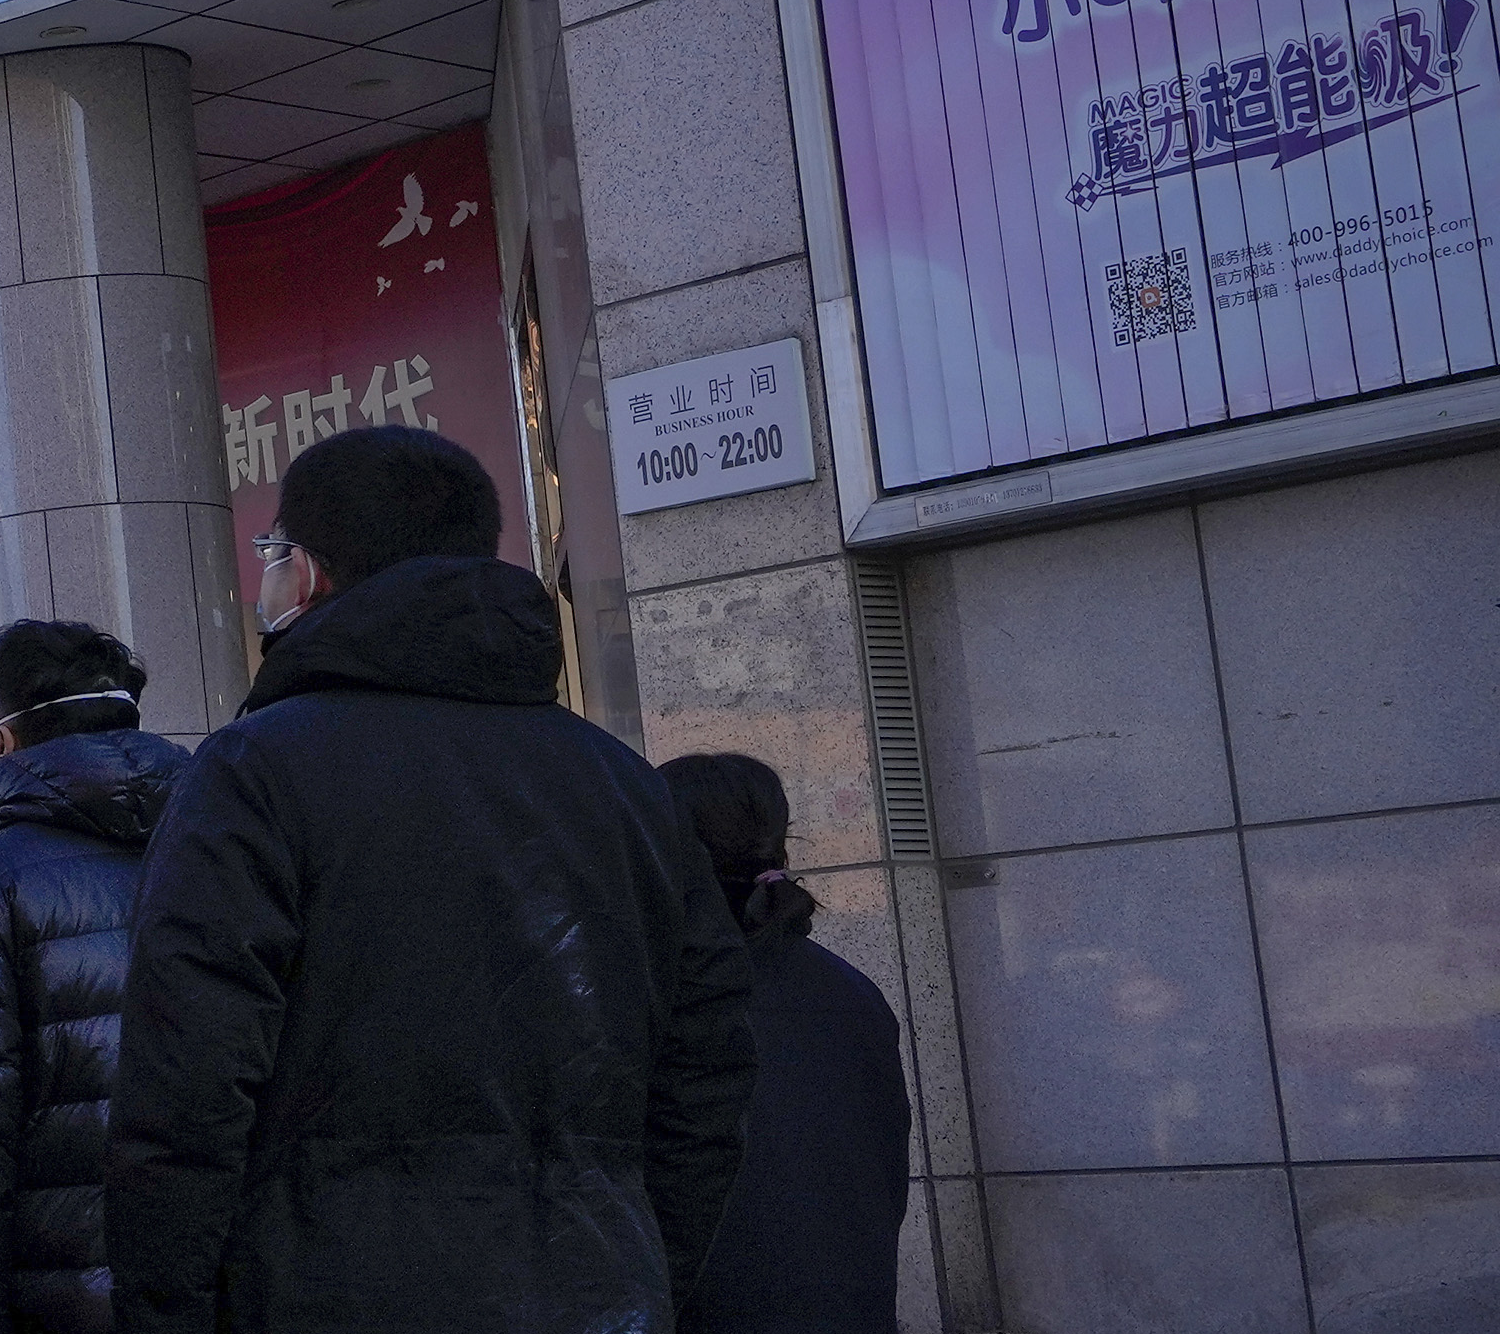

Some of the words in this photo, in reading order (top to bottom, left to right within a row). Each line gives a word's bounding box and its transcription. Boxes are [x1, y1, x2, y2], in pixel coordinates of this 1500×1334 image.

[1093, 78, 1194, 122] MAGIC
[1288, 200, 1433, 248] 400-996-5015
[1290, 217, 1473, 267] www.daddychoice.com
[1294, 235, 1494, 292] sales@daddychoice.com
[628, 365, 777, 425] 营业时间
[655, 414, 713, 436] BUSINESS
[717, 405, 755, 423] HOUR
